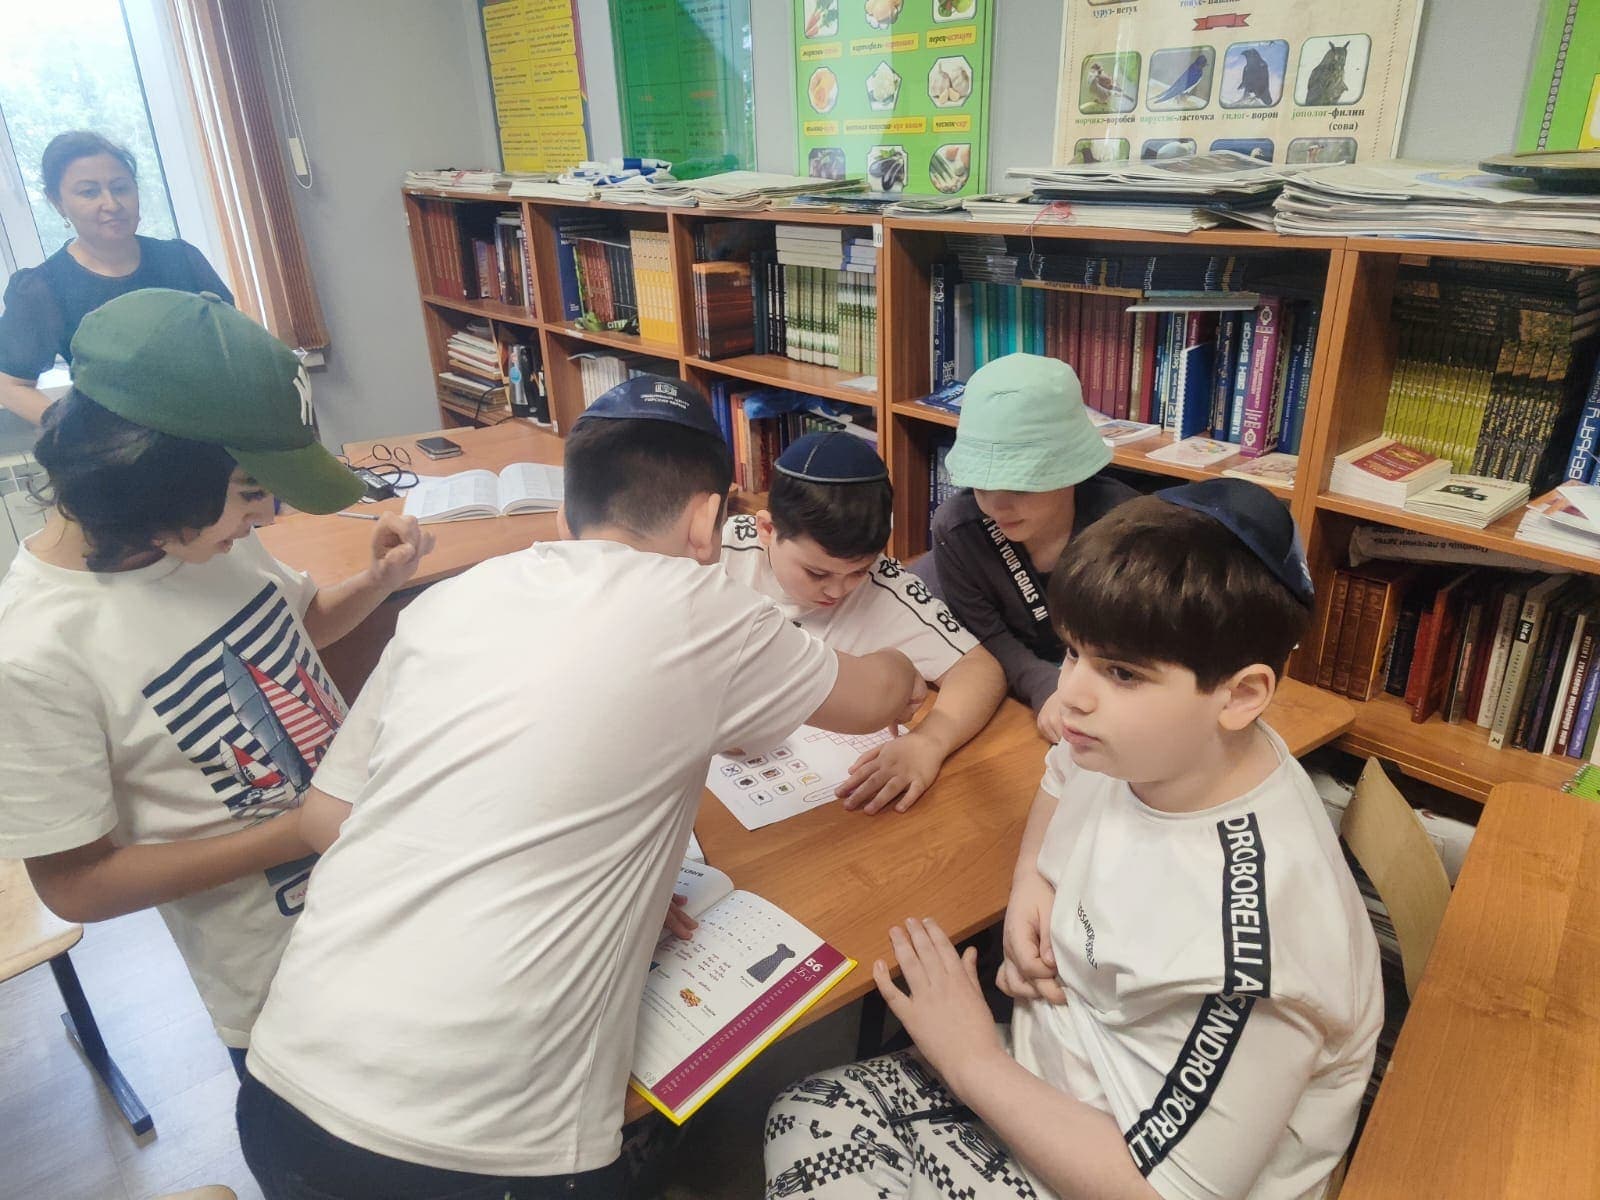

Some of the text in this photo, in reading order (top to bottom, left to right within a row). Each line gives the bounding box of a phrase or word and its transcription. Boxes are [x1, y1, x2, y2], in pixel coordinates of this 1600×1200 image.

[1251, 110, 1279, 121] ворон
[1328, 122, 1358, 131] (сова)
[1000, 543, 1022, 573] YOUR
[1014, 569, 1040, 604] GOALS
[804, 957, 824, 973] Бб
